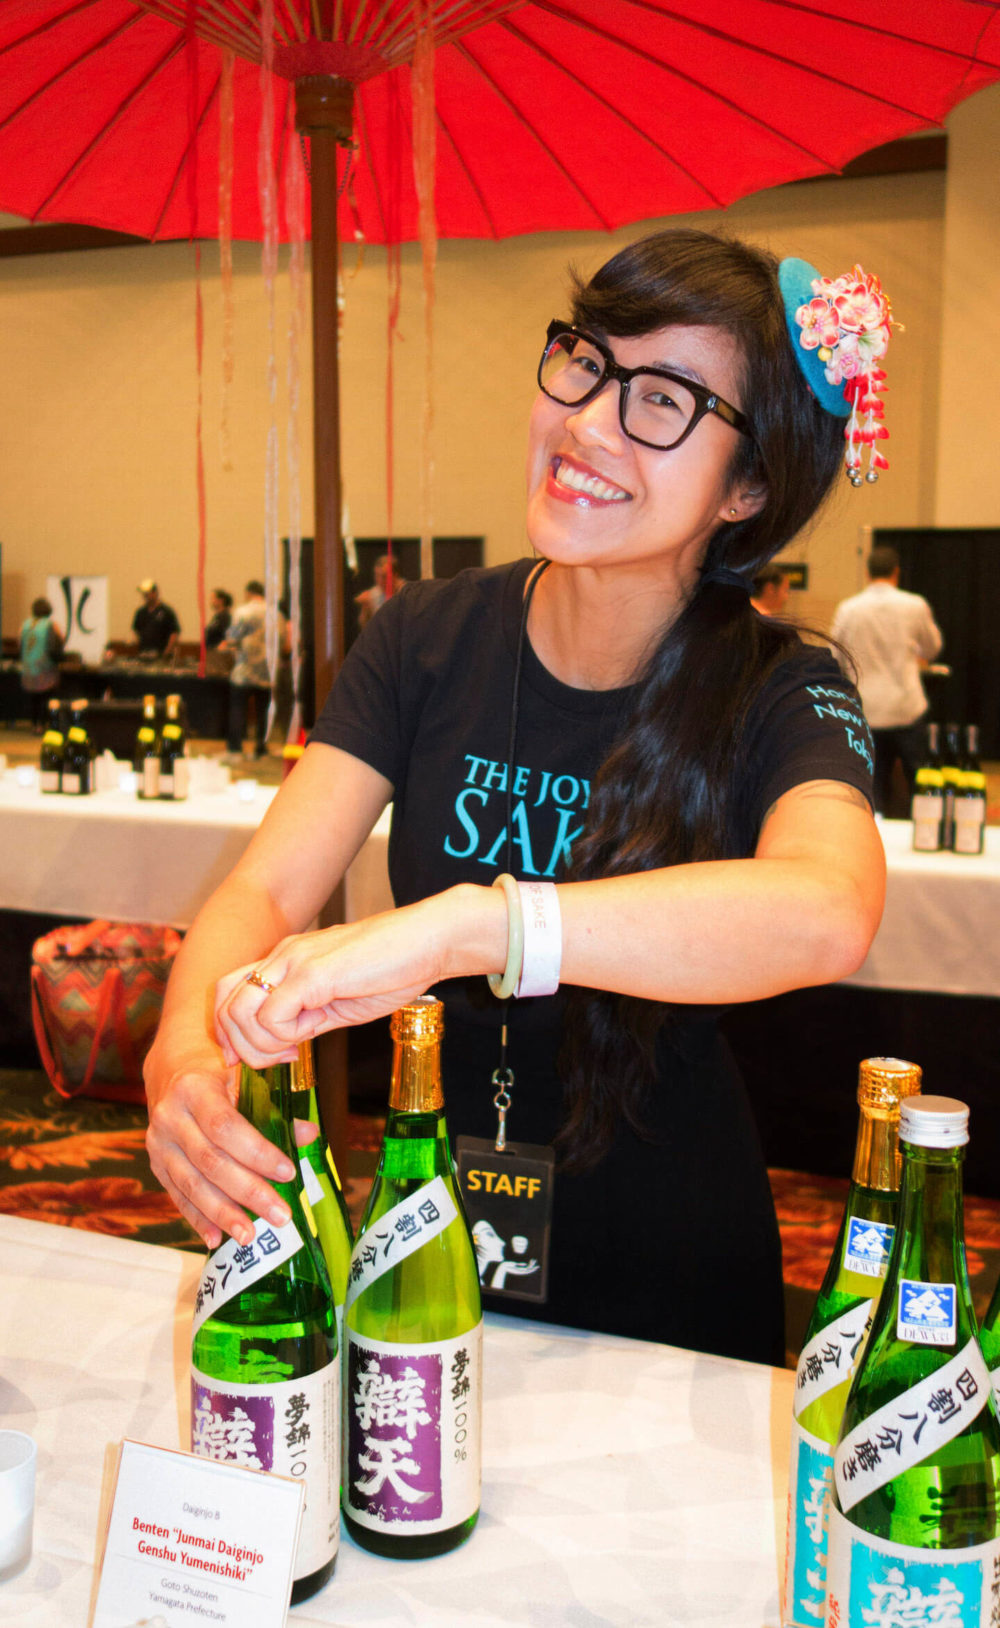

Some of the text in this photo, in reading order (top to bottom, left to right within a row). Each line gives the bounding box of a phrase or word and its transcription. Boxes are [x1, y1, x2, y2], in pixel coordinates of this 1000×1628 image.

[813, 703, 862, 727] New
[464, 754, 531, 796] THE
[443, 787, 585, 877] SAK
[532, 897, 547, 929] SAKE
[466, 1169, 542, 1199] STAFF
[842, 1367, 978, 1482] 四割八分磨き
[182, 1502, 213, 1520] Daiginjo
[132, 1517, 264, 1566] Benten “Junmai Daiginjo
[137, 1540, 253, 1582] Genshu Yumenishiki”
[161, 1578, 219, 1602] Goto Shuzoten
[149, 1591, 226, 1622] Yamagata Prefecture
